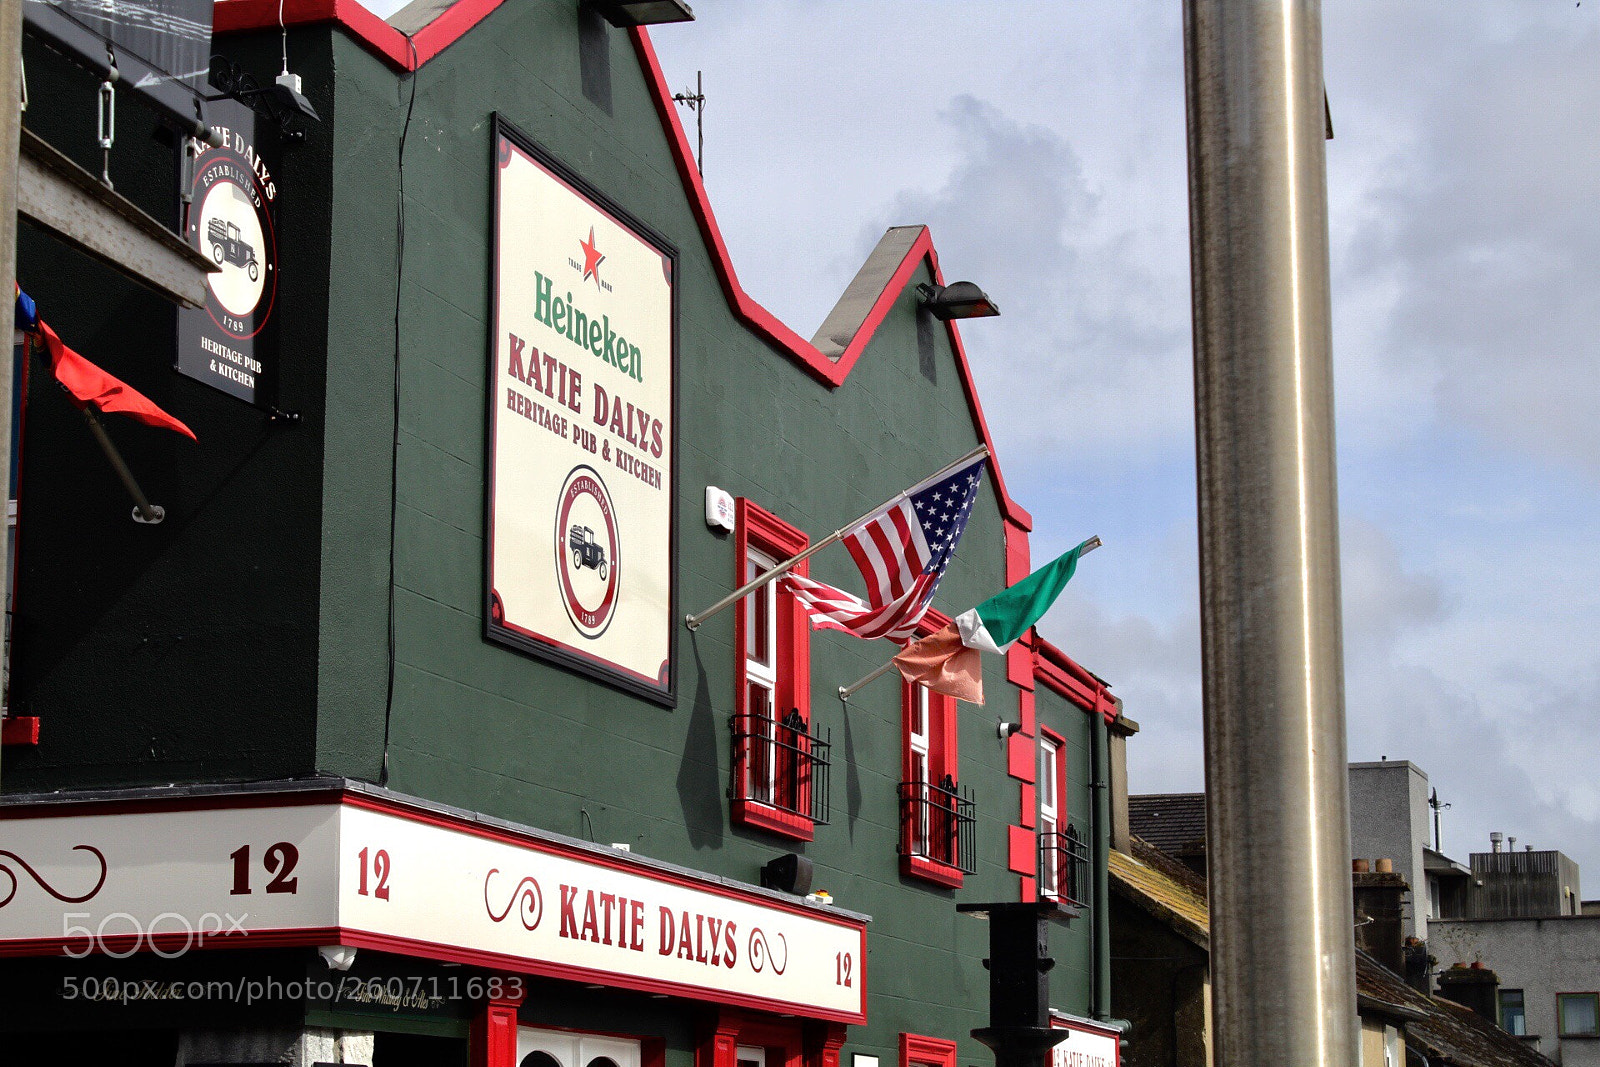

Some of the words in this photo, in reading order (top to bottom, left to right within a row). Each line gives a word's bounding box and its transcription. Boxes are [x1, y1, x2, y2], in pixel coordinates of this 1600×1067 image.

[203, 165, 261, 208] ESTABLISHED
[234, 132, 277, 200] DALYS
[223, 315, 244, 332] 1789
[534, 270, 643, 383] Heineken
[201, 336, 243, 366] HERITAGE
[244, 355, 262, 374] PUB
[209, 358, 217, 372] &
[218, 362, 255, 388] KITCHEN
[508, 332, 582, 414] KATIE
[593, 382, 663, 459] DALYS
[507, 387, 568, 439] HERITAGE
[573, 423, 597, 455] PUB
[602, 438, 612, 462] &
[616, 447, 662, 490] KITCHEN
[570, 480, 608, 515] ESTABLISHED
[581, 611, 596, 625] 1789
[229, 841, 300, 896] 12
[357, 846, 391, 903] 12
[559, 884, 644, 952] KATIE
[659, 905, 738, 970] DALYS
[835, 950, 853, 989] 12
